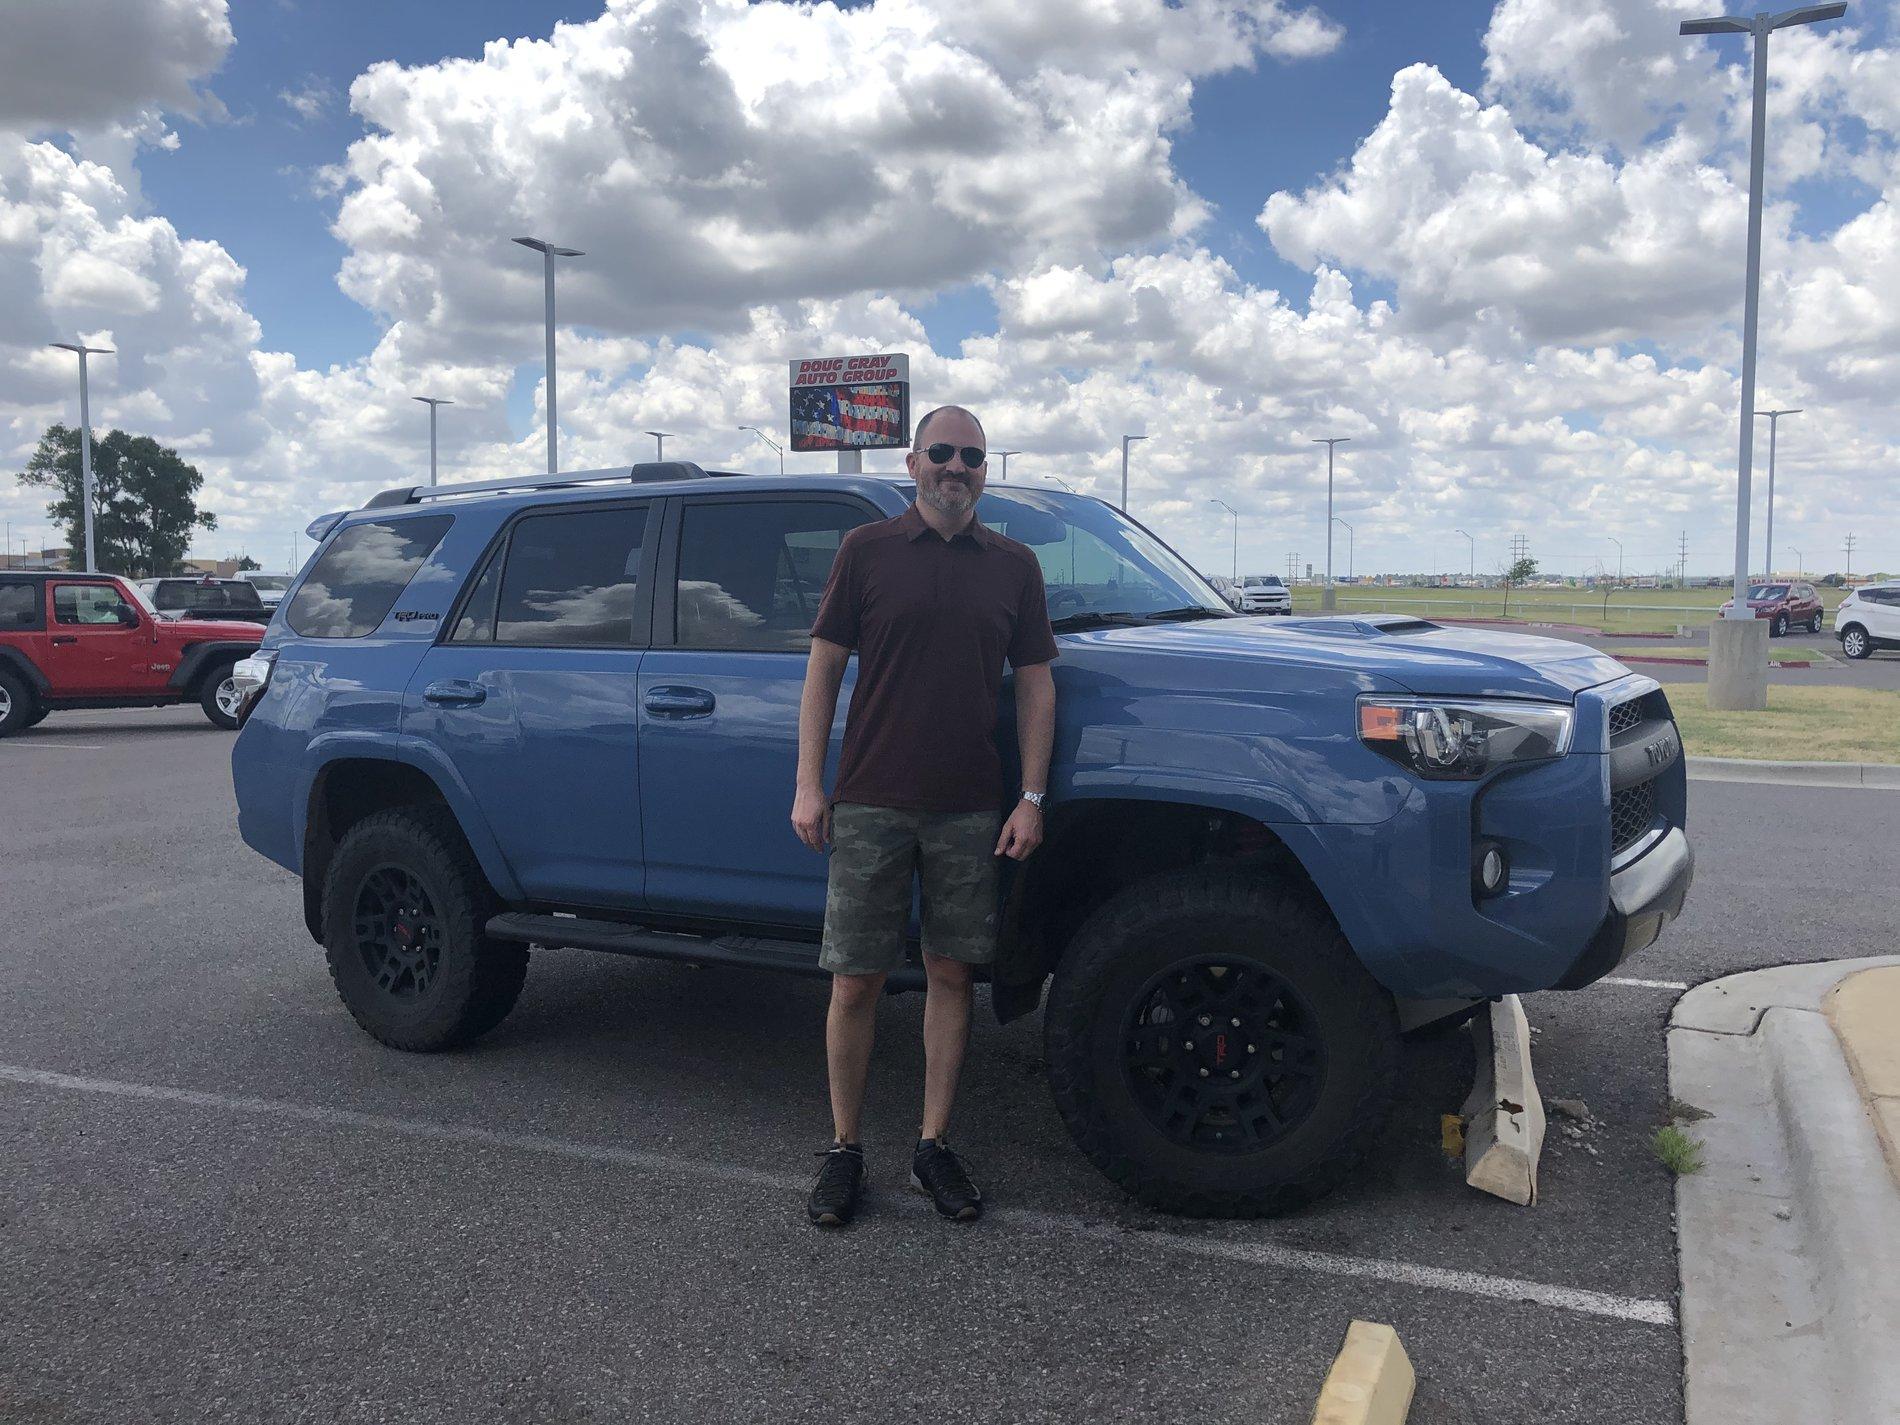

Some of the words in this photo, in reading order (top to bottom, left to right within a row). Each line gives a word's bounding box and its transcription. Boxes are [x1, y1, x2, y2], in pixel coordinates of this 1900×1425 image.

[799, 358, 844, 373] DOUG
[848, 356, 892, 370] GRAY
[795, 369, 838, 386] AUTO
[842, 368, 898, 383] GROUP
[151, 662, 171, 672] Jeep
